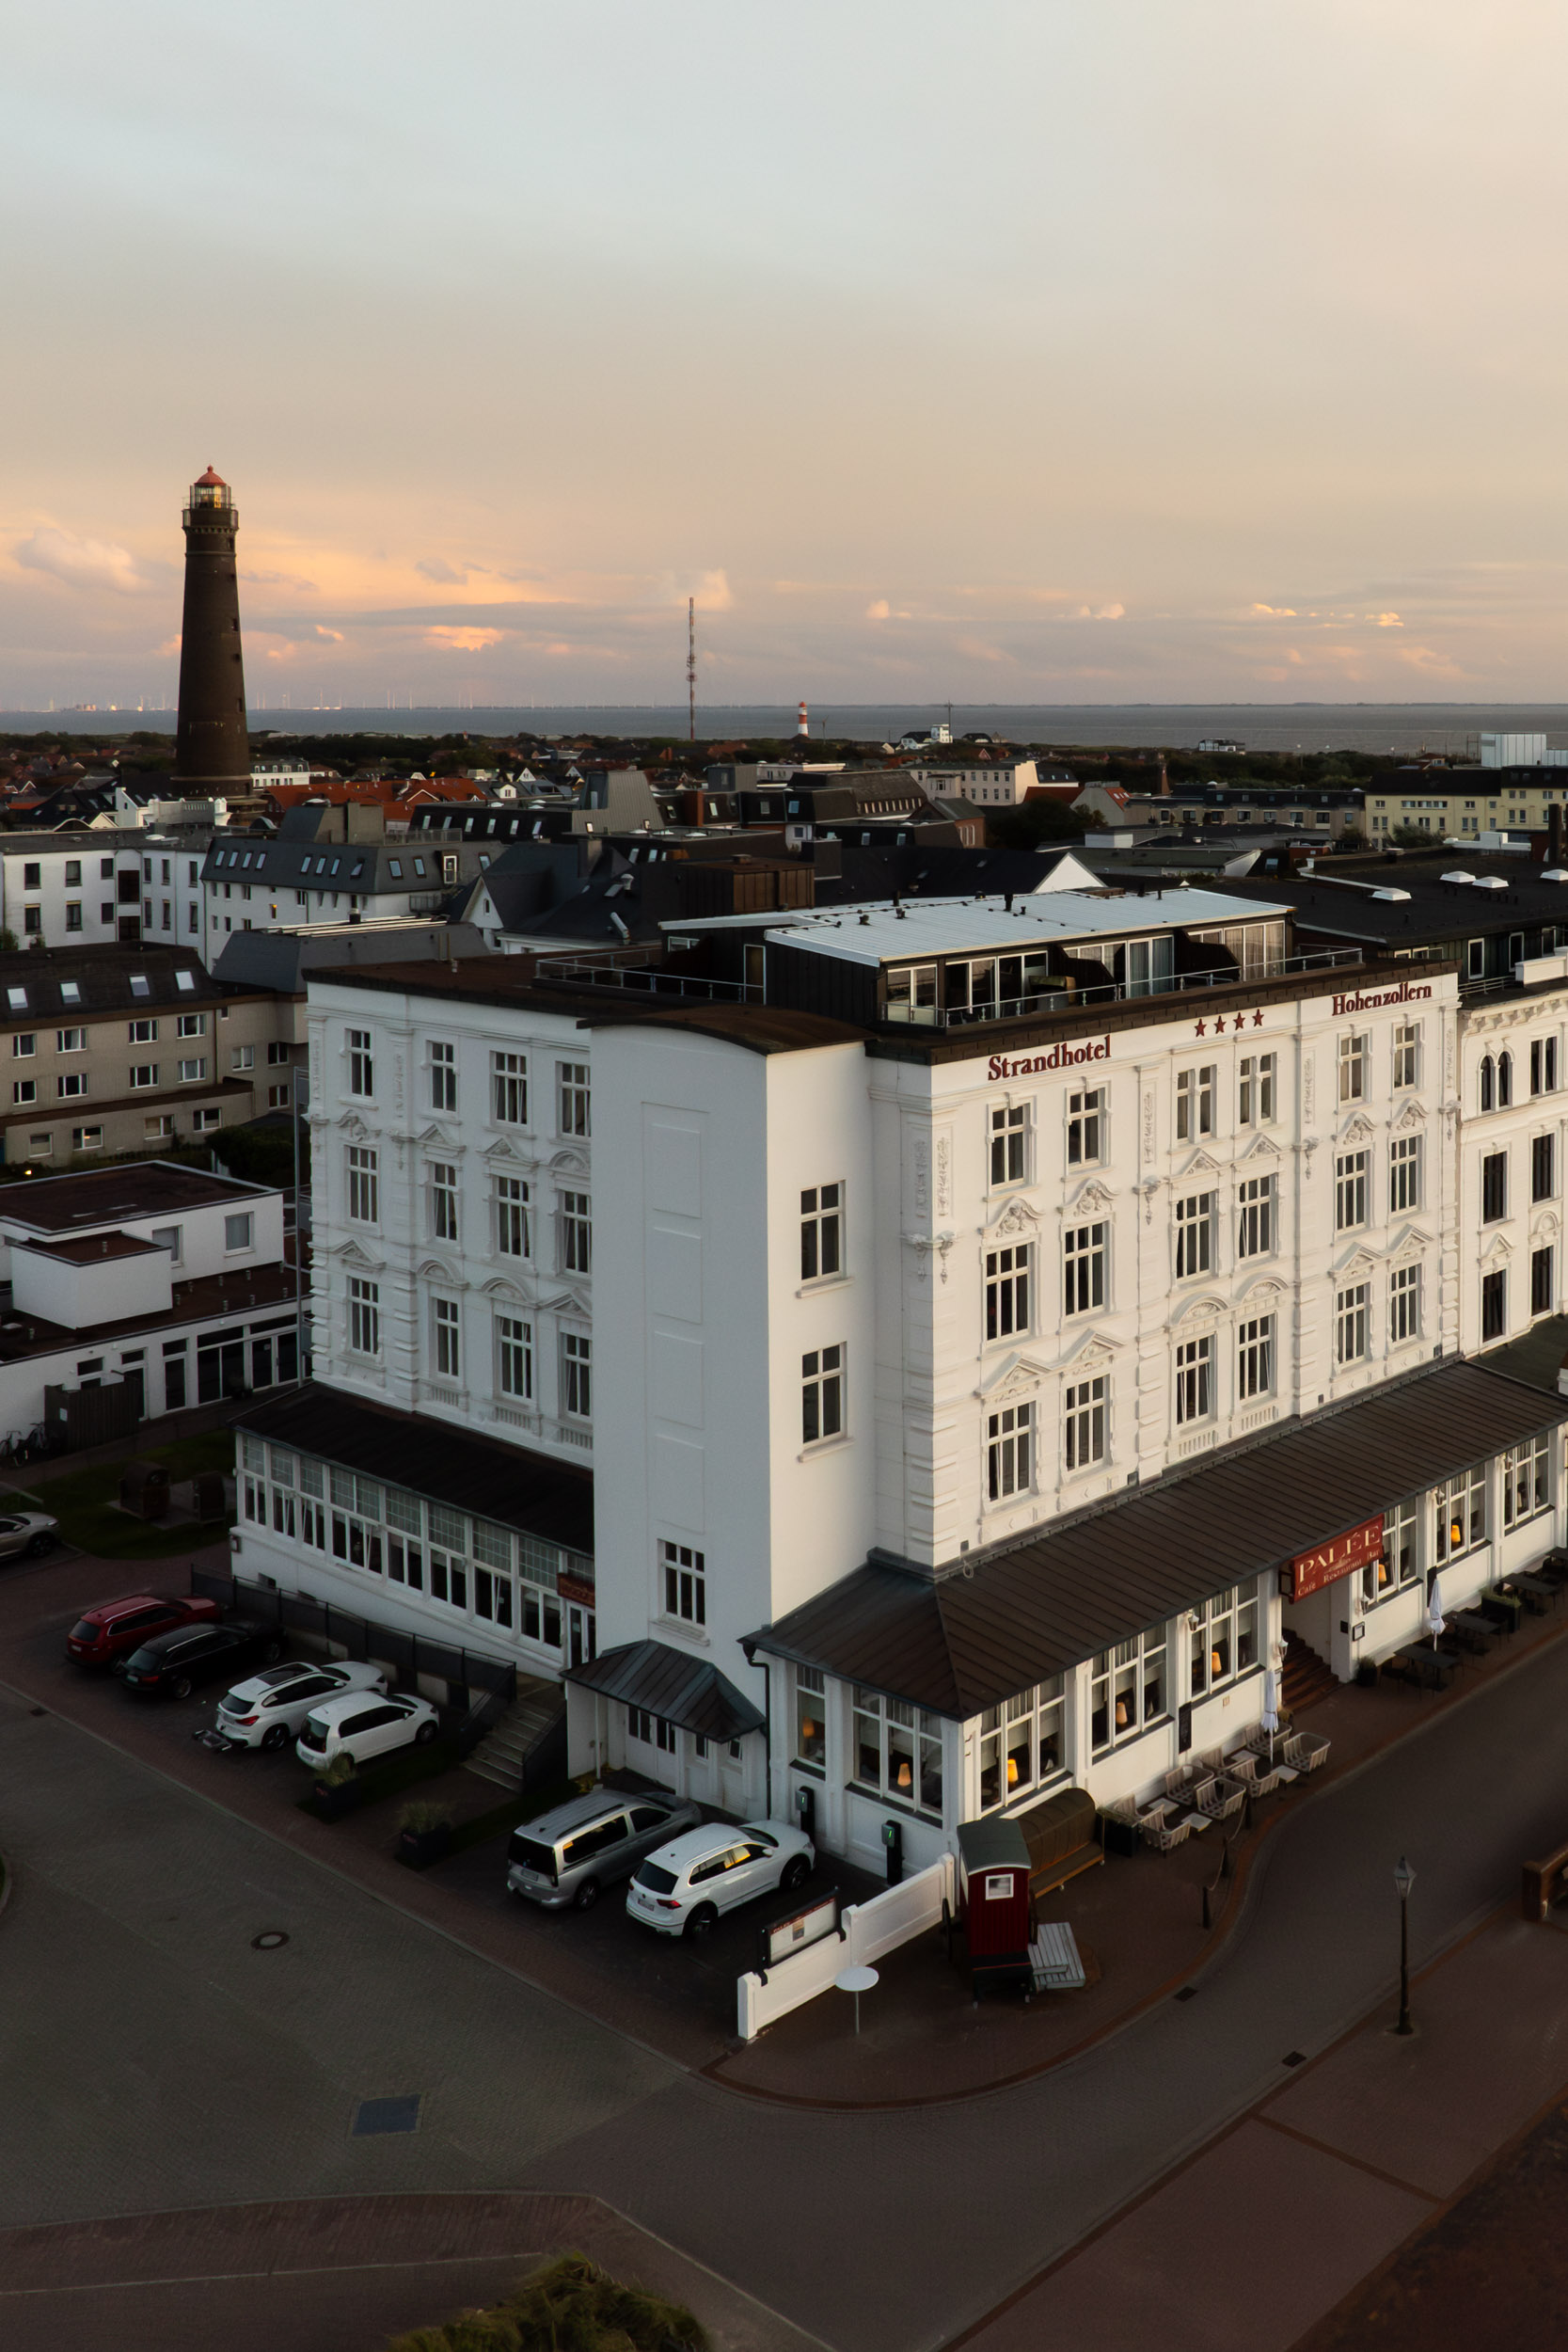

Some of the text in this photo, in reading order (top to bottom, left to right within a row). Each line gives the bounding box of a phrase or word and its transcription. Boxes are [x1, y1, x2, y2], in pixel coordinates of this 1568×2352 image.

[988, 981, 1433, 1081] Strandhotel Hohenzollern
[1298, 1549, 1380, 1597] Café Restaurant Bar
[1300, 1525, 1380, 1582] PALÉE
